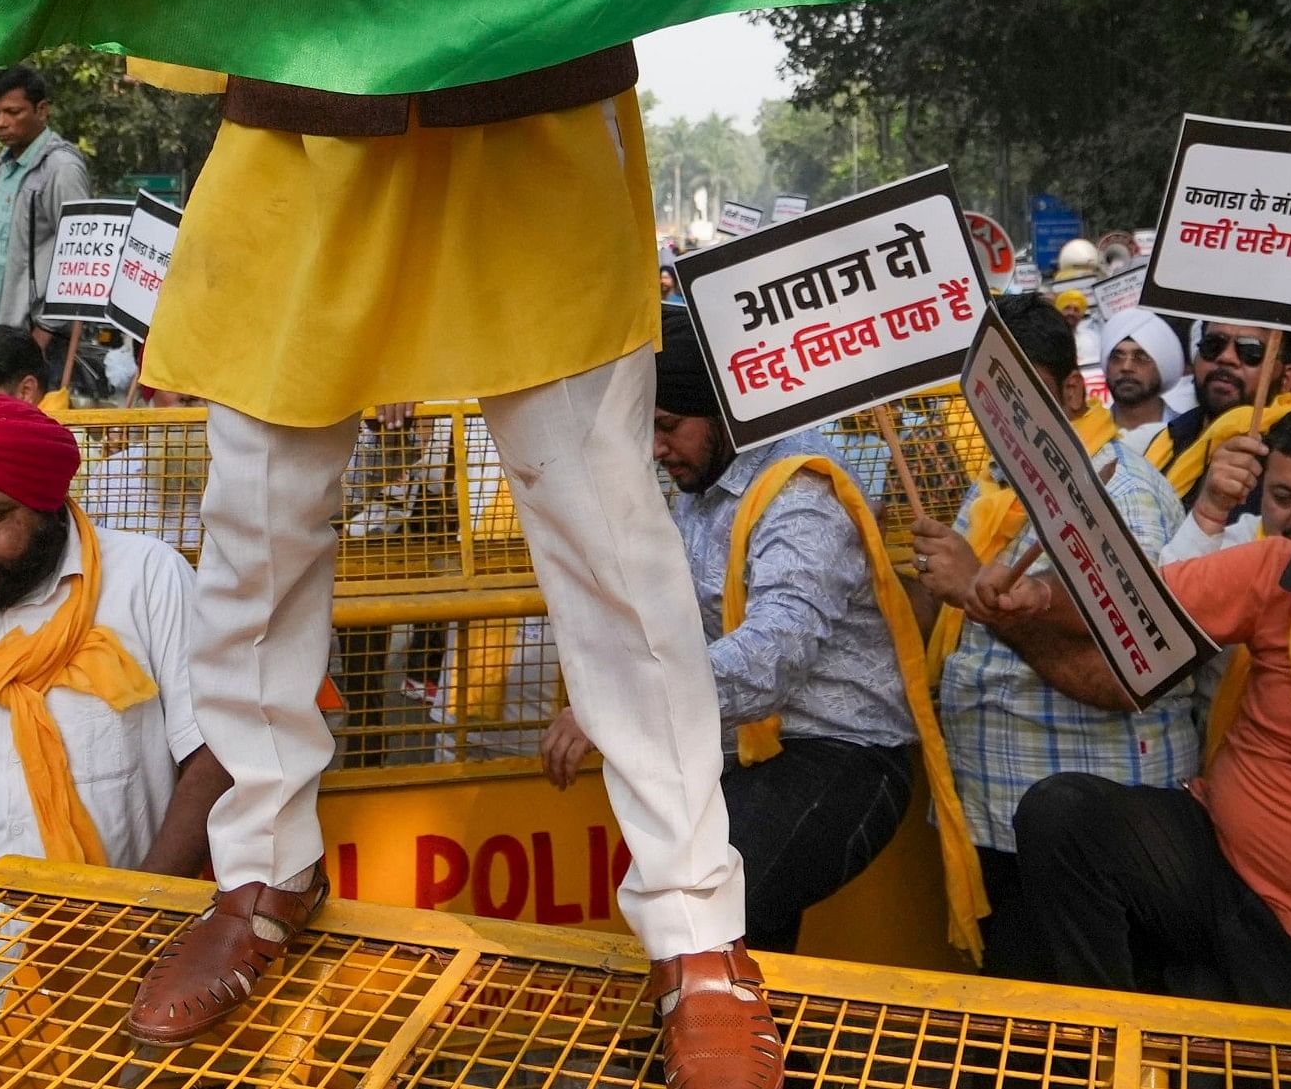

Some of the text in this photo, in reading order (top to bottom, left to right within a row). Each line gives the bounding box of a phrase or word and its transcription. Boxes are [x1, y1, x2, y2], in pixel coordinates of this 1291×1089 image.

[1185, 186, 1247, 210] कनाडा
[1249, 189, 1271, 212] के
[68, 222, 129, 238] STOP TH
[1179, 218, 1239, 250] नहीं
[58, 242, 114, 257] ATTACKS
[57, 262, 110, 277] TEMPLES
[734, 223, 932, 332] आवाज दो
[728, 277, 973, 395] हिंदू सिख एक हैं
